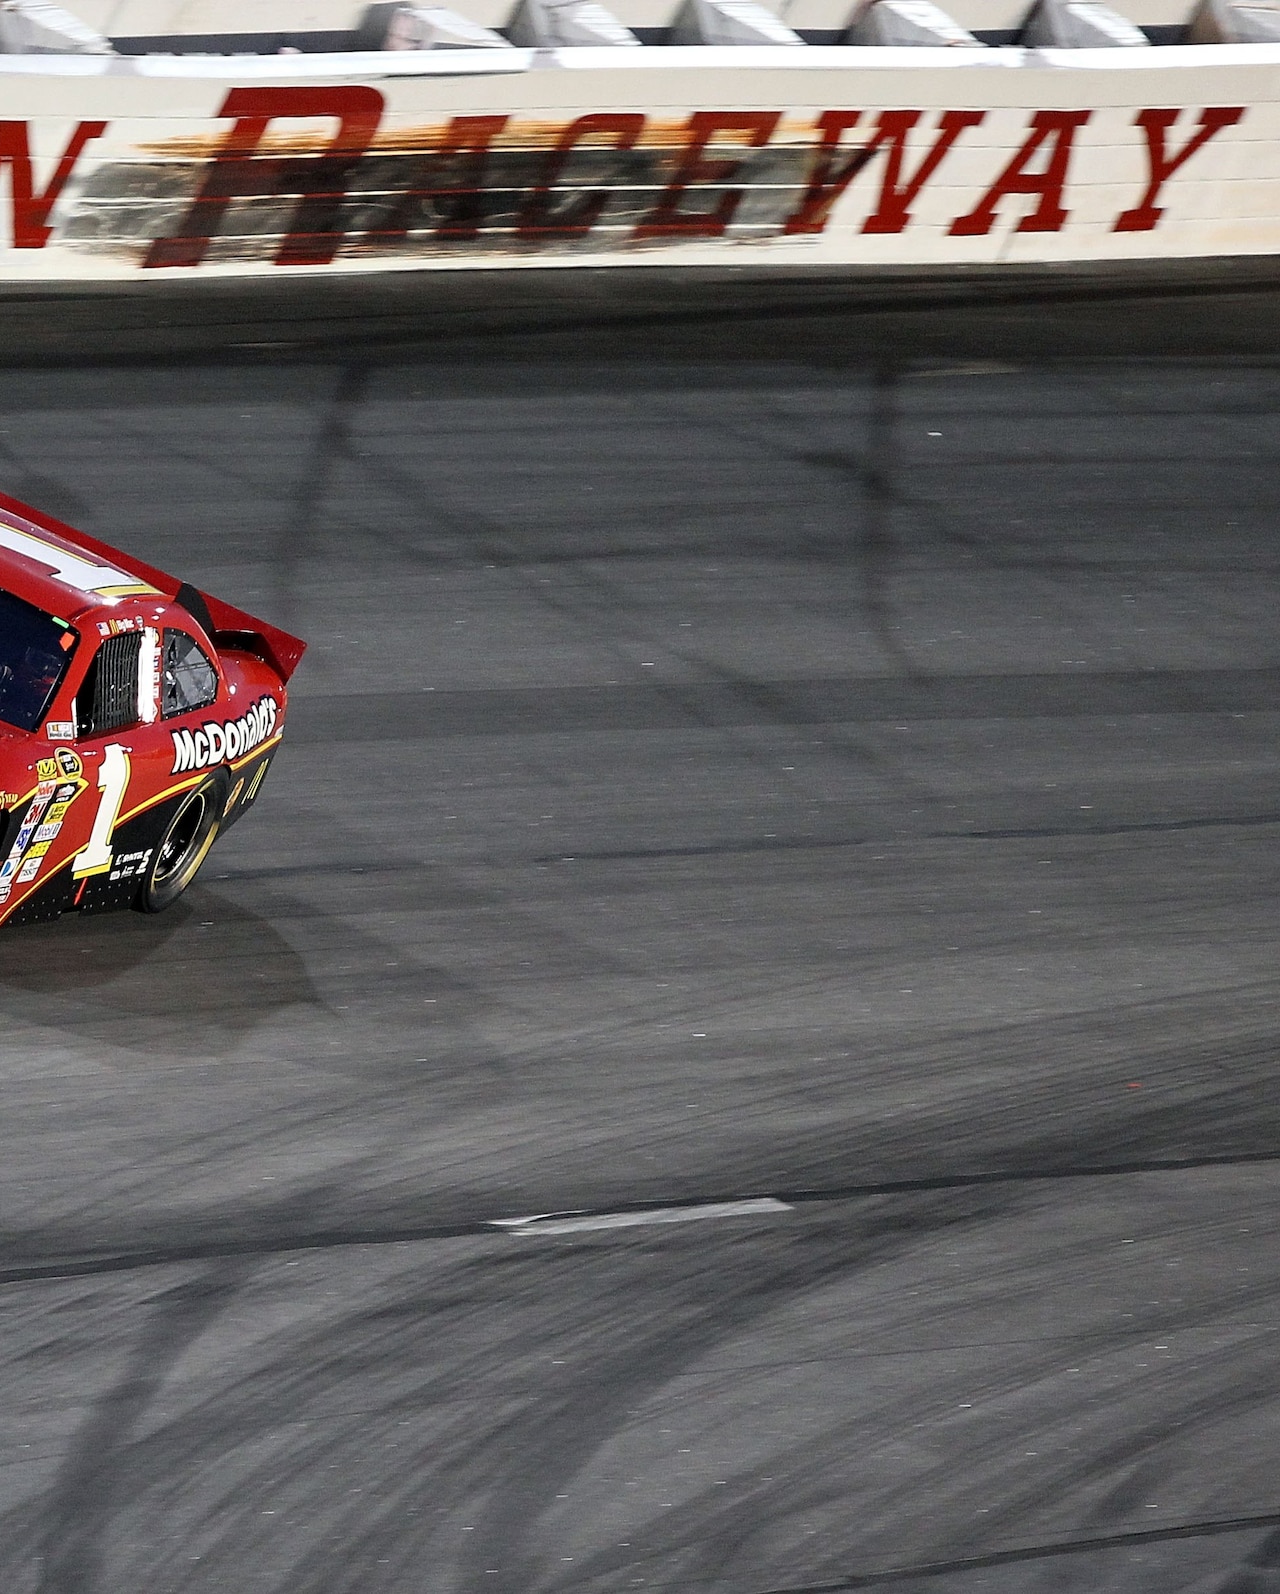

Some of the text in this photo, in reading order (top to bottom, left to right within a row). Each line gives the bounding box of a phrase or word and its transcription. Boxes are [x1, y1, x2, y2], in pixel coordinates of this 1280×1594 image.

[140, 86, 1251, 270] RACEWAY
[171, 697, 278, 774] McDonald's
[72, 743, 131, 879] 1
